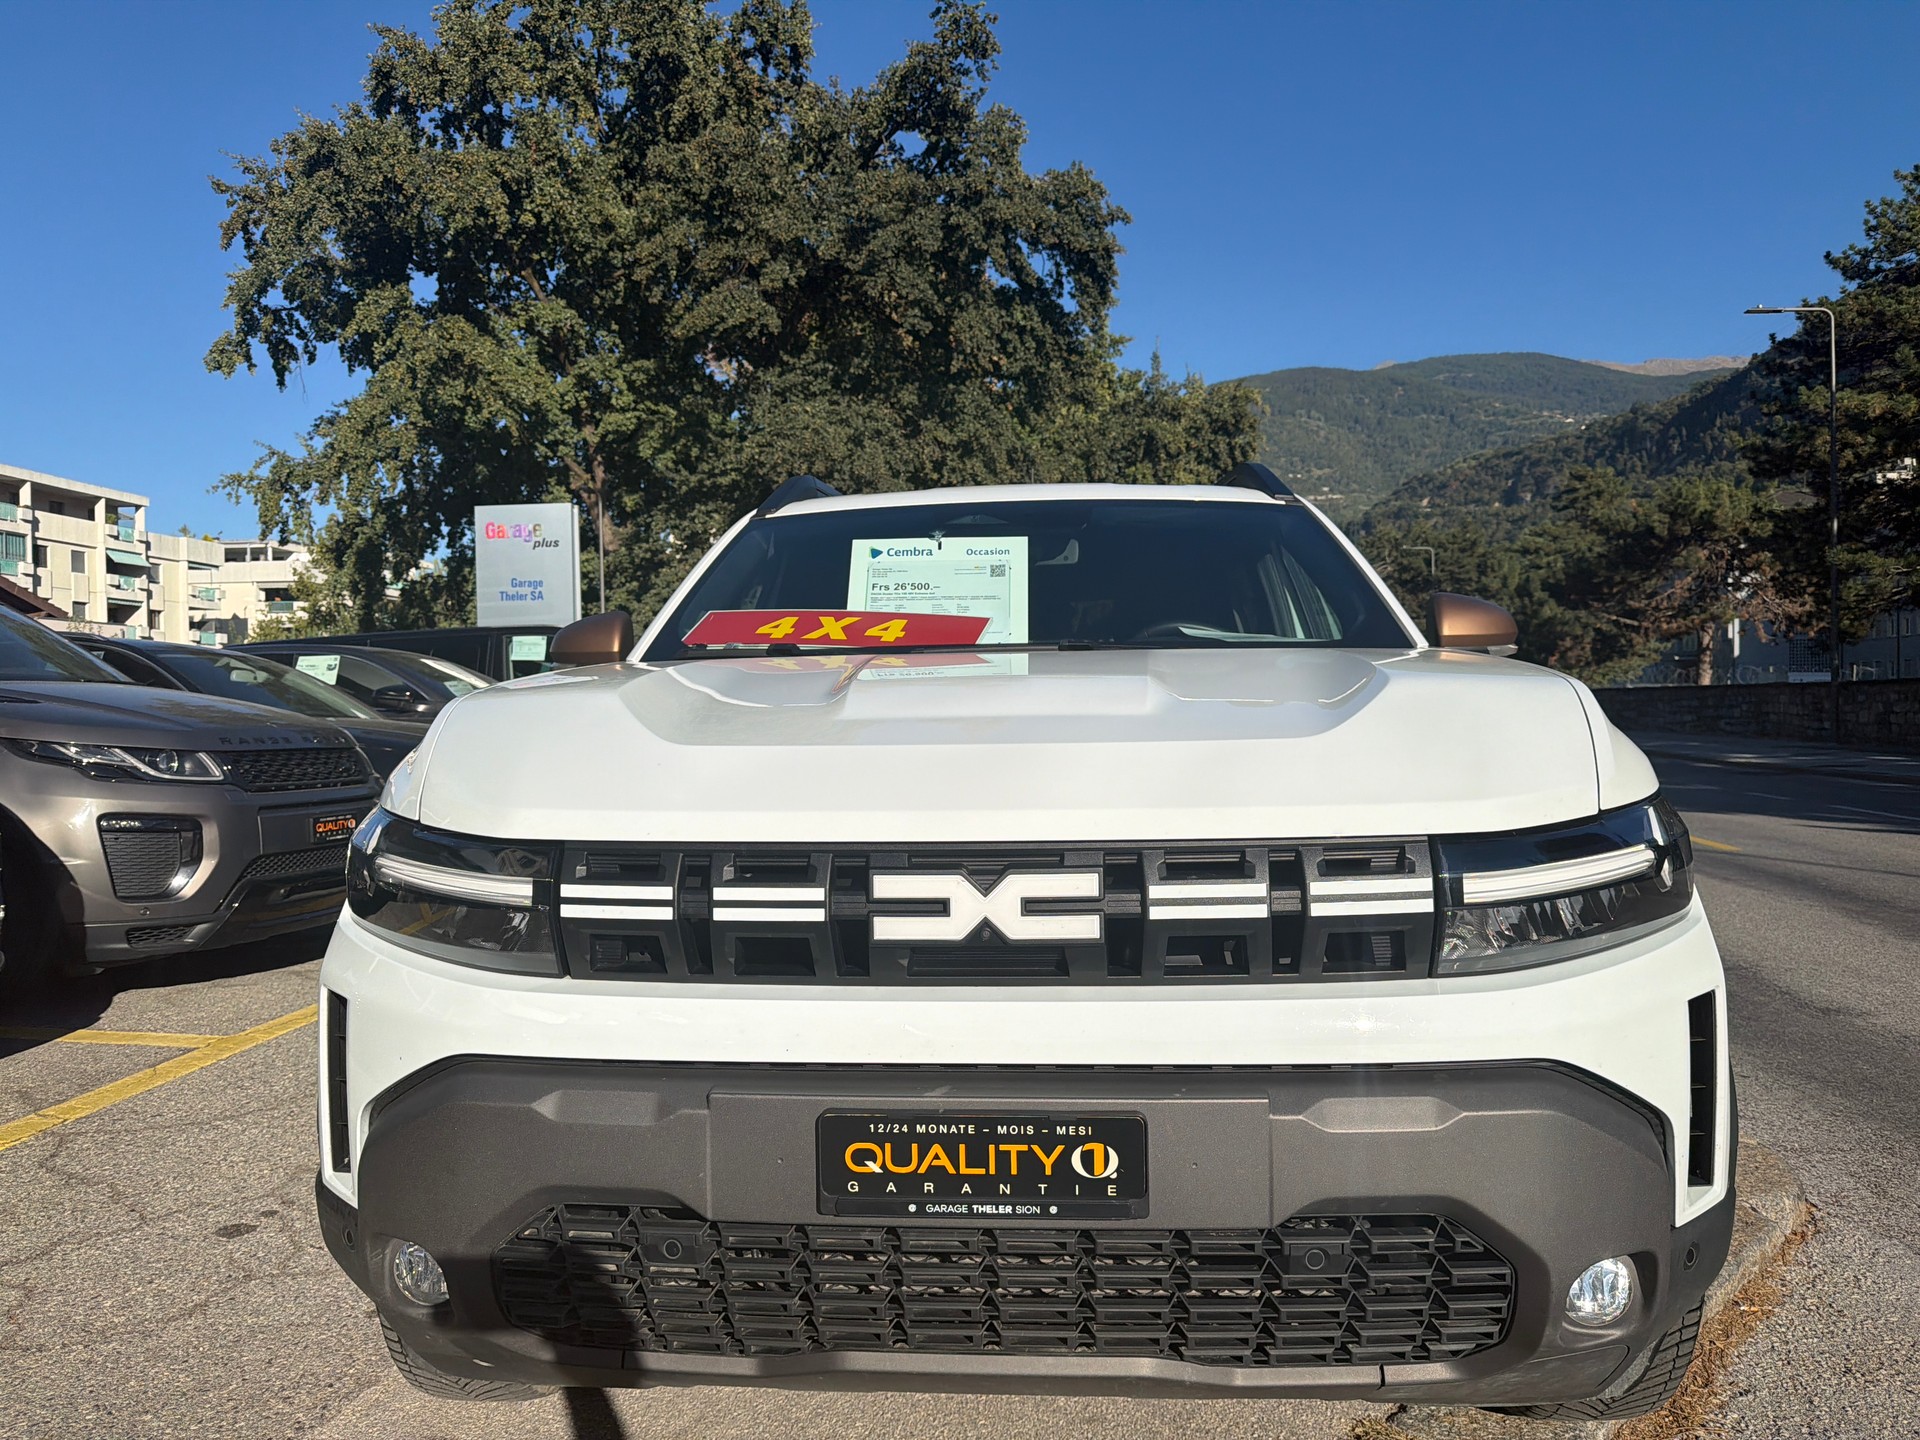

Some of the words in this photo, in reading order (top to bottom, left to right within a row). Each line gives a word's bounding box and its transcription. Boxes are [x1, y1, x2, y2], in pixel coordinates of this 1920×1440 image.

[485, 521, 542, 543] Gaage
[532, 538, 560, 550] plus
[886, 547, 934, 557] Cembra
[966, 547, 1010, 556] Occasion
[510, 578, 544, 590] Garage
[871, 583, 890, 592] Frs
[499, 591, 528, 602] Theler
[530, 590, 544, 601] SA
[316, 820, 348, 832] QUALITY
[869, 1123, 909, 1133] 12/24
[916, 1124, 976, 1134] MONATE
[997, 1125, 1034, 1135] MOIS
[1056, 1125, 1092, 1136] MESI
[847, 1181, 1118, 1196] GARANTIE
[925, 1204, 969, 1213] GARAGE
[971, 1204, 1013, 1214] THELER
[1015, 1205, 1041, 1214] SION
